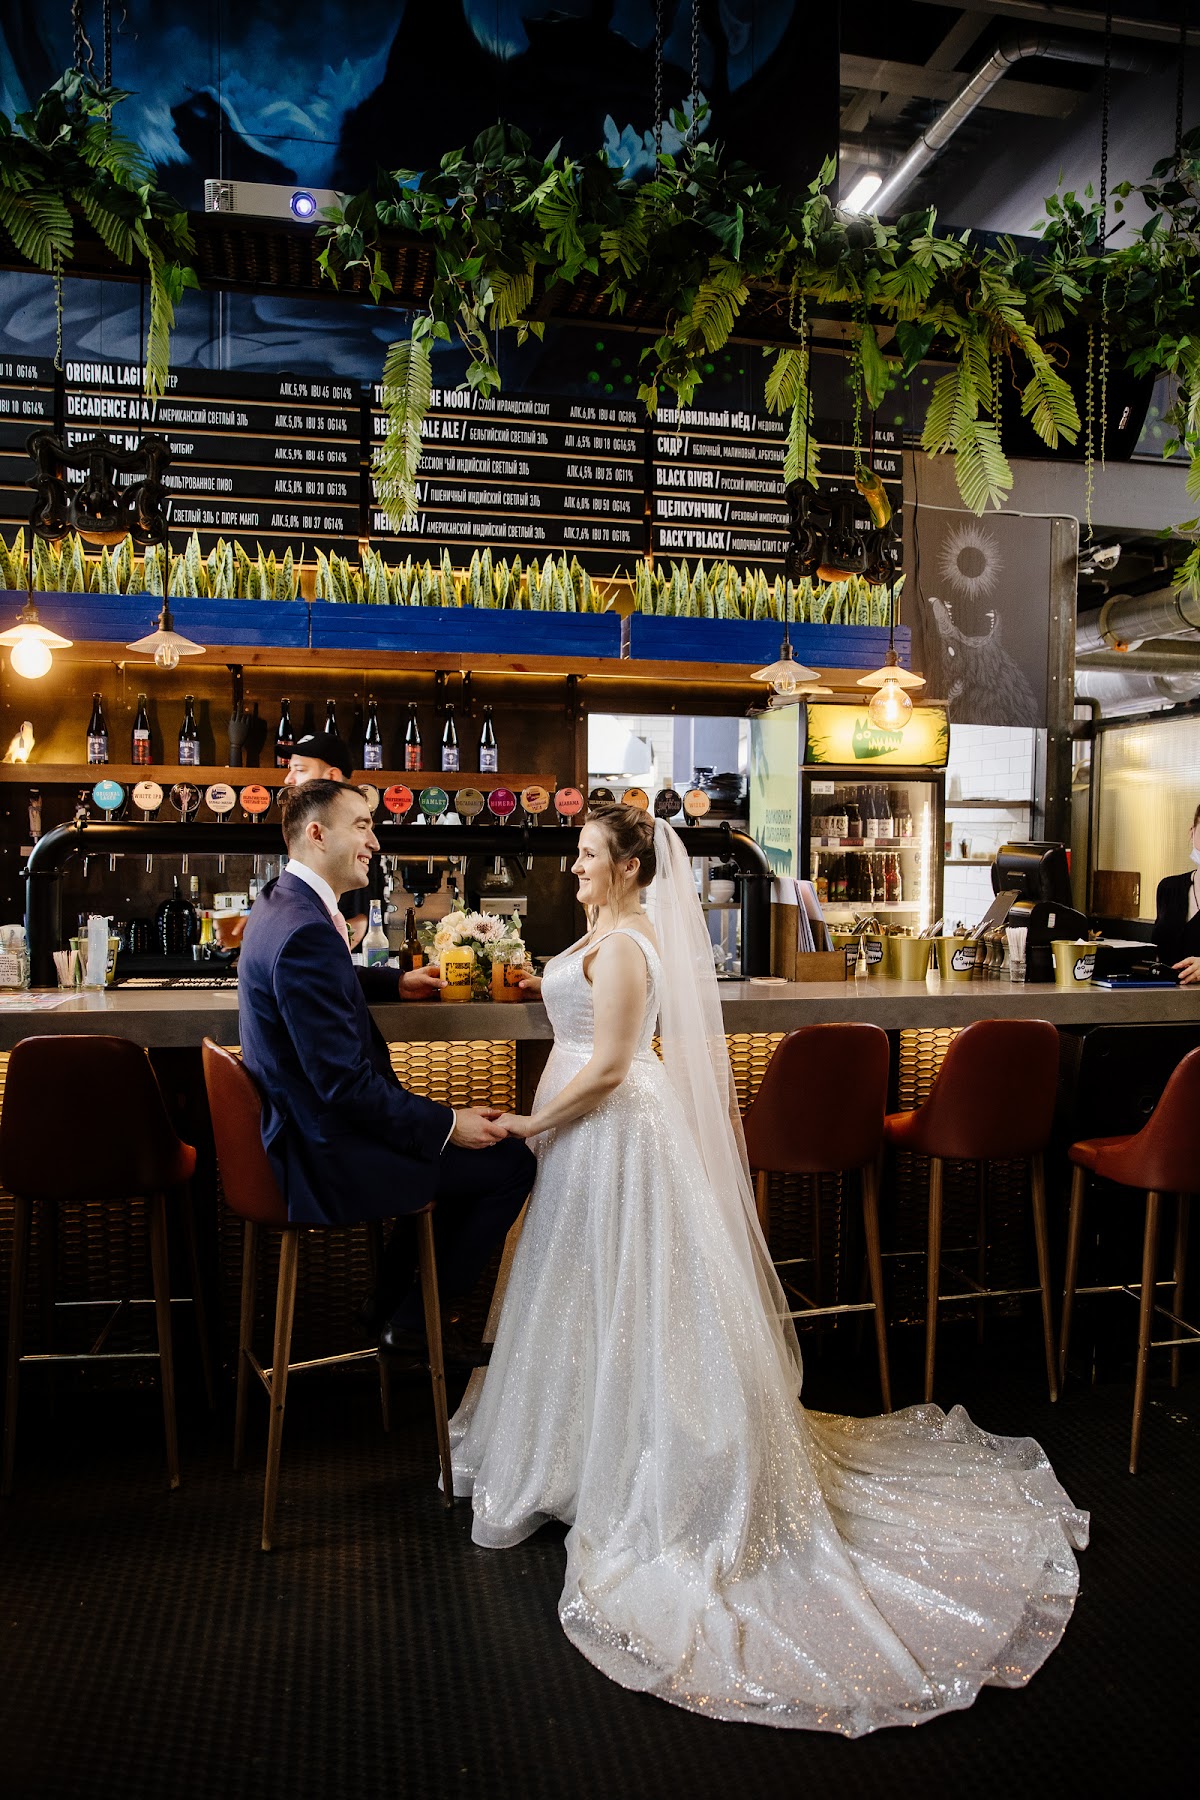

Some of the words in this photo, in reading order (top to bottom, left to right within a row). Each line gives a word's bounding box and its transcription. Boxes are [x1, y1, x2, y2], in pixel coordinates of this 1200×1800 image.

[5, 363, 12, 377] 18
[66, 362, 115, 384] ORIGINAL
[311, 385, 321, 398] IBU
[322, 386, 330, 399] 45
[332, 386, 352, 400] OG14%
[22, 401, 44, 415] OG14%
[67, 396, 126, 419] DECADENCE
[159, 408, 206, 424] АМЕРИКАНСКИЙ
[207, 410, 235, 425] СВЕТЛЫЙ
[236, 413, 248, 426] ЭЛЬ
[306, 416, 316, 429] IBU
[317, 417, 325, 430] 35
[327, 418, 348, 432] OG14%
[429, 389, 441, 406] HE
[443, 390, 471, 409] MOON
[478, 397, 496, 411] СУХОЙ
[496, 399, 533, 415] ИРЛАНДСКИЙ
[534, 403, 550, 415] СТАУТ
[598, 408, 609, 421] IBU
[657, 408, 730, 428] НЕПРАВИЛЬНЫЙ
[731, 412, 751, 431] МЁД
[441, 421, 460, 439] ALE
[469, 427, 509, 442] БЕЛЬГИЙСКИЙ
[510, 430, 536, 444] СВЕТЛЫЙ
[537, 432, 548, 445] ЭЛЬ
[593, 436, 603, 449] IBU
[604, 438, 611, 450] 18
[306, 449, 315, 461] IBU
[317, 450, 324, 462] 45
[657, 437, 683, 456] СИДР
[693, 444, 722, 458] ЯБЛОЧНЫЙ,
[723, 446, 757, 460] МАЛИНОВЫЙ,
[456, 457, 491, 474] ИНДИЙСКИЙ
[492, 460, 518, 475] СВЕТЛЫЙ
[518, 462, 530, 475] ЭЛЬ
[595, 467, 605, 480] IBU
[605, 467, 613, 481] 25
[656, 468, 686, 487] BLACK
[687, 470, 714, 488] RIVER
[721, 477, 744, 491] РУССКИЙ
[745, 479, 776, 493] ИМПЕРСКИЙ
[161, 475, 215, 491] ЕФИЛЬТРОВАННОЕ
[216, 478, 233, 491] ПИВО
[306, 481, 315, 494] IBU
[317, 482, 324, 495] 20
[430, 489, 467, 503] ПШЕНИЧНЫЙ
[467, 490, 502, 505] ИНДИЙСКИЙ
[502, 492, 529, 507] СВЕТЛЫЙ
[529, 495, 541, 507] ЭЛЬ
[592, 498, 603, 511] IBU
[603, 499, 610, 511] 50
[173, 508, 201, 523] СВЕТЛЫЙ
[202, 510, 214, 524] ЭЛЬ
[216, 511, 220, 524] С
[221, 512, 238, 525] ПЮРЕ
[239, 513, 259, 526] МАНГО
[302, 515, 313, 529] IBU
[314, 516, 321, 529] 37
[657, 500, 722, 519] ЩЕЛКУНЧИК
[731, 510, 758, 522] ОРЕХОВЫЙ
[759, 512, 790, 524] ИМПЕРСКИЙ
[426, 521, 472, 535] АМЕРИКАНСКИЙ
[472, 522, 507, 537] ИНДИЙСКИЙ
[507, 524, 534, 538] СВЕТЛЫЙ
[534, 527, 546, 540] ЭЛЬ
[592, 528, 602, 541] IBU
[602, 529, 610, 541] 70
[660, 529, 725, 549] BACK'N'BLACK
[732, 538, 761, 551] МОЛОЧНЫЙ
[762, 540, 777, 553] СТАУТ
